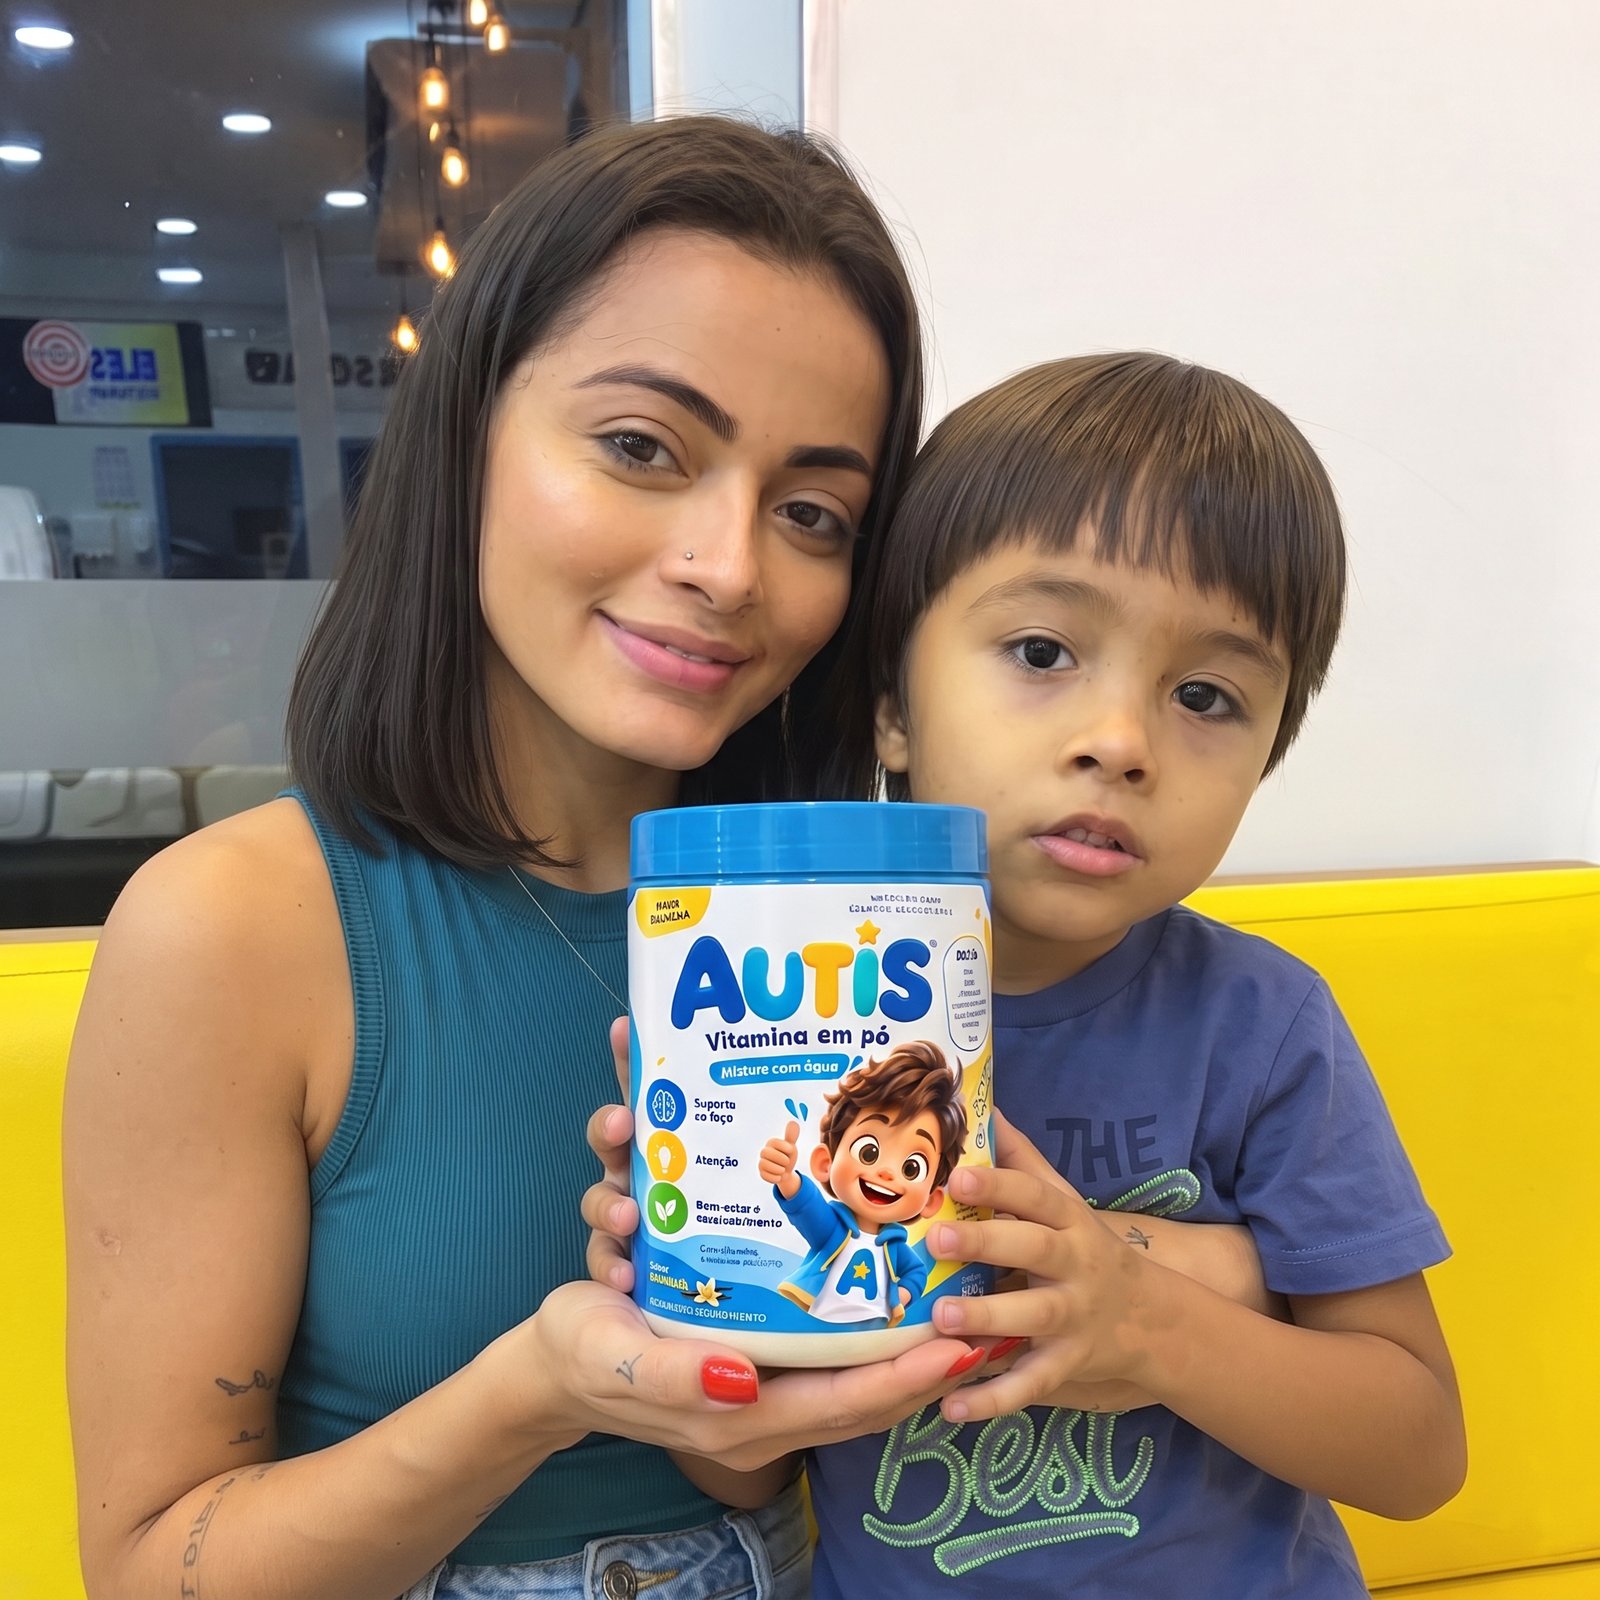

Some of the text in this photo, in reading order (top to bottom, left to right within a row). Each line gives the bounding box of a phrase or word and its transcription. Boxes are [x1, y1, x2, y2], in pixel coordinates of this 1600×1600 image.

[704, 1024, 891, 1052] Vitamina em pó
[771, 1063, 801, 1074] com
[803, 1058, 839, 1076] água
[1045, 1113, 1164, 1184] THE
[695, 1154, 739, 1170] Atenção
